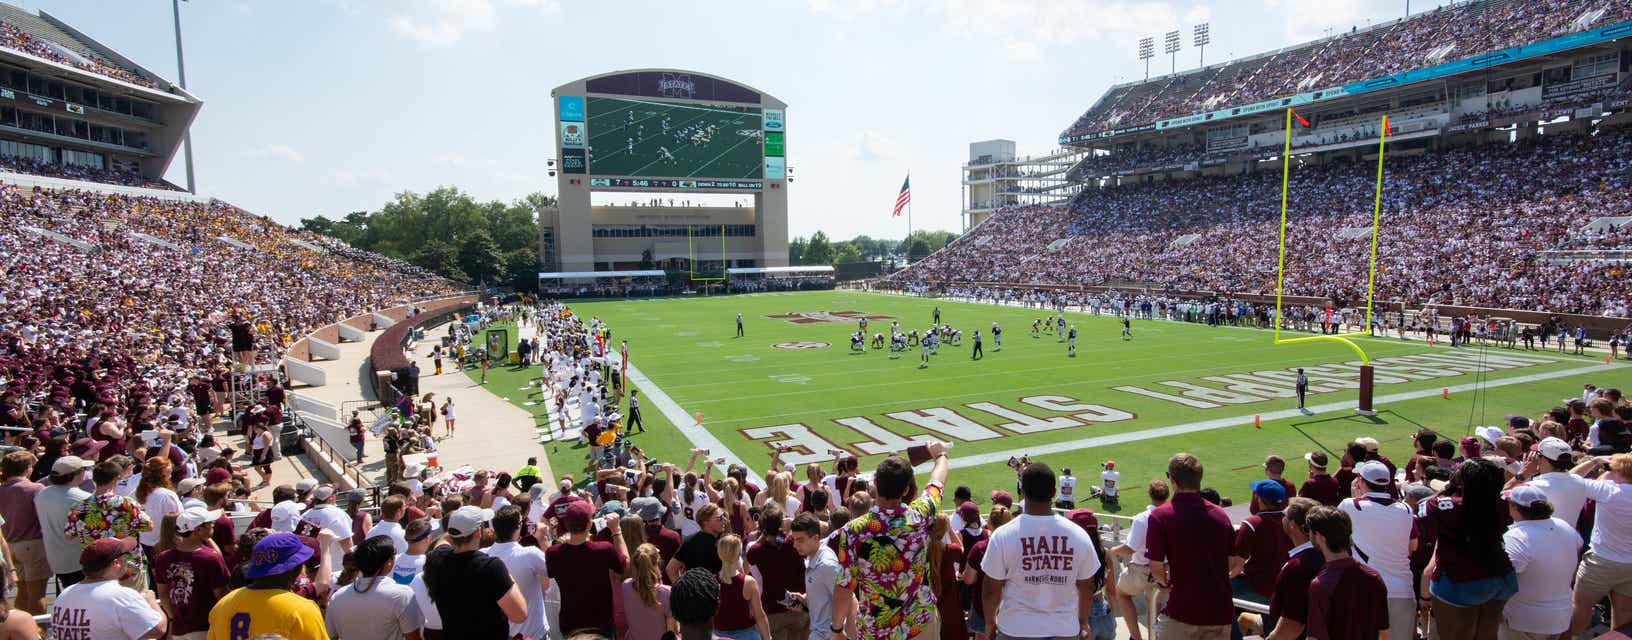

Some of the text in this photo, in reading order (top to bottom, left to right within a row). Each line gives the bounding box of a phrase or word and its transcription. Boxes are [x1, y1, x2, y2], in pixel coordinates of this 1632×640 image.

[737, 394, 1138, 467] STATE
[1020, 535, 1074, 556] HAIL
[1022, 554, 1073, 571] STATE
[51, 606, 91, 627] HAIL
[52, 625, 91, 640] STATE
